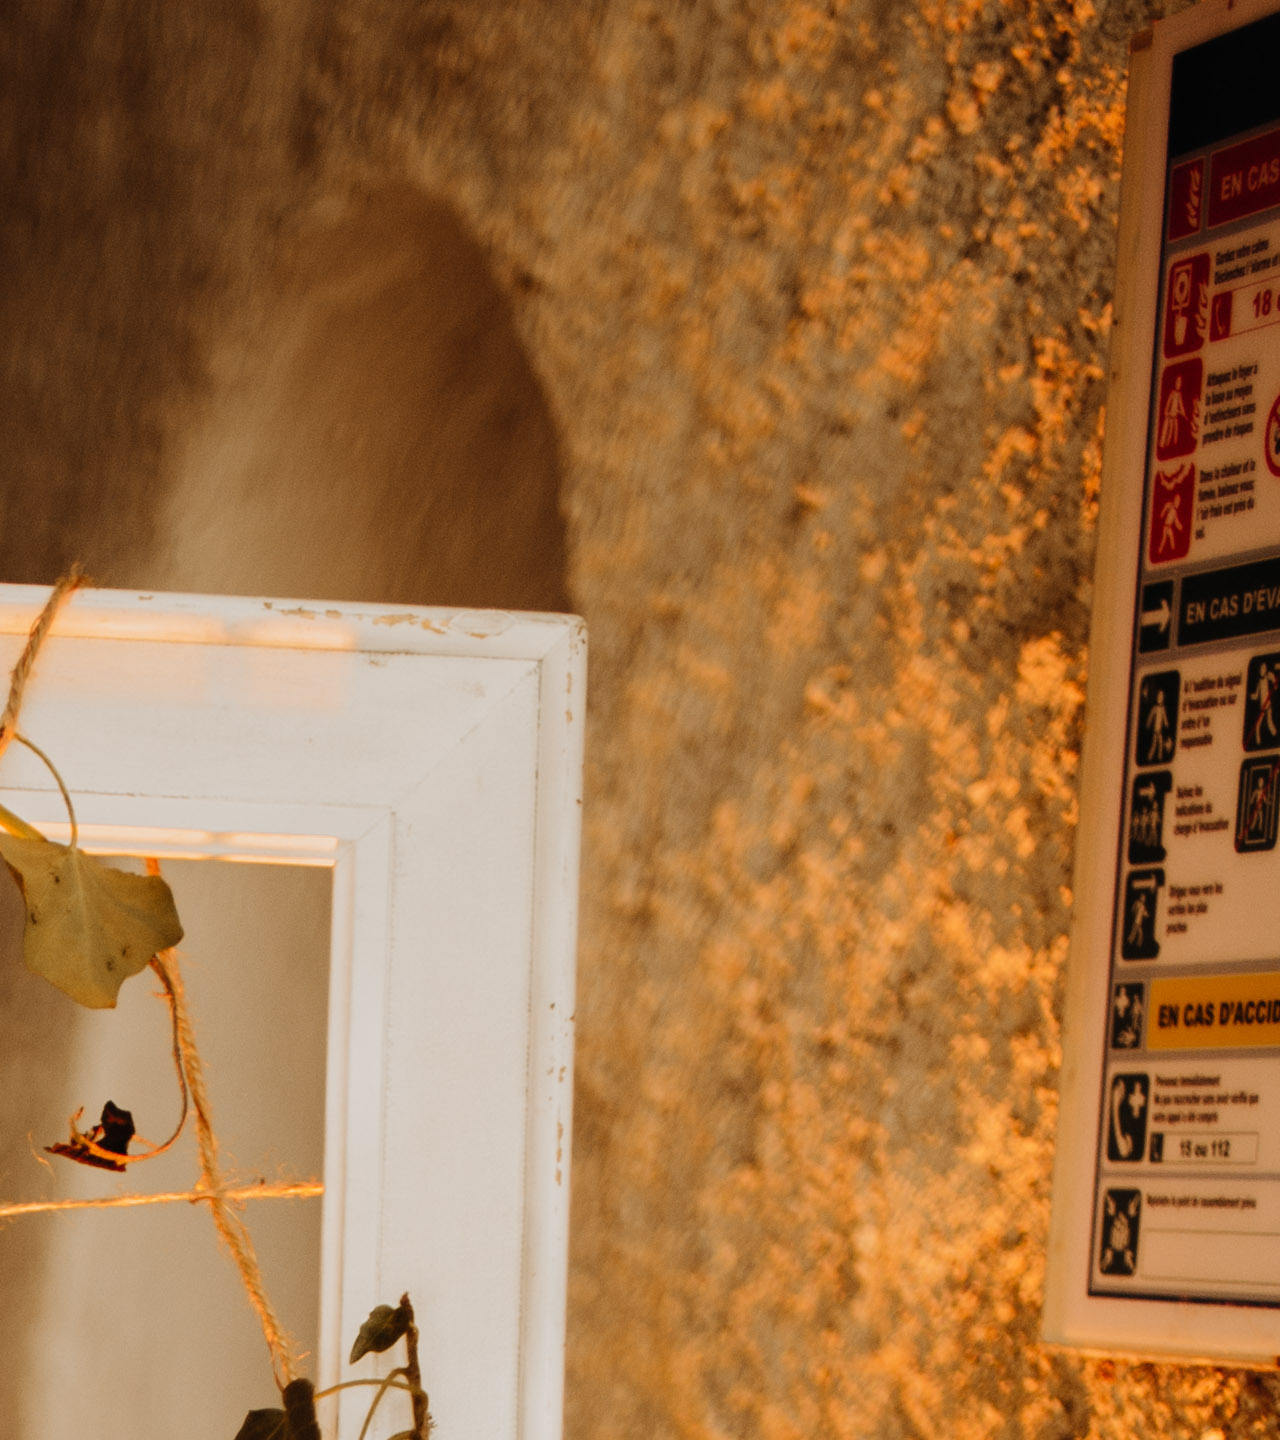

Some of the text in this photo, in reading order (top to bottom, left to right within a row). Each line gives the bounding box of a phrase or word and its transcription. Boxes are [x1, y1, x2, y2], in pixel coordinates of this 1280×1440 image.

[1221, 158, 1279, 201] EN CAS
[1252, 288, 1273, 319] 18
[1186, 602, 1206, 625] EN
[1210, 594, 1239, 620] CAS
[1158, 1003, 1180, 1029] EN
[1183, 1002, 1215, 1028] CAS
